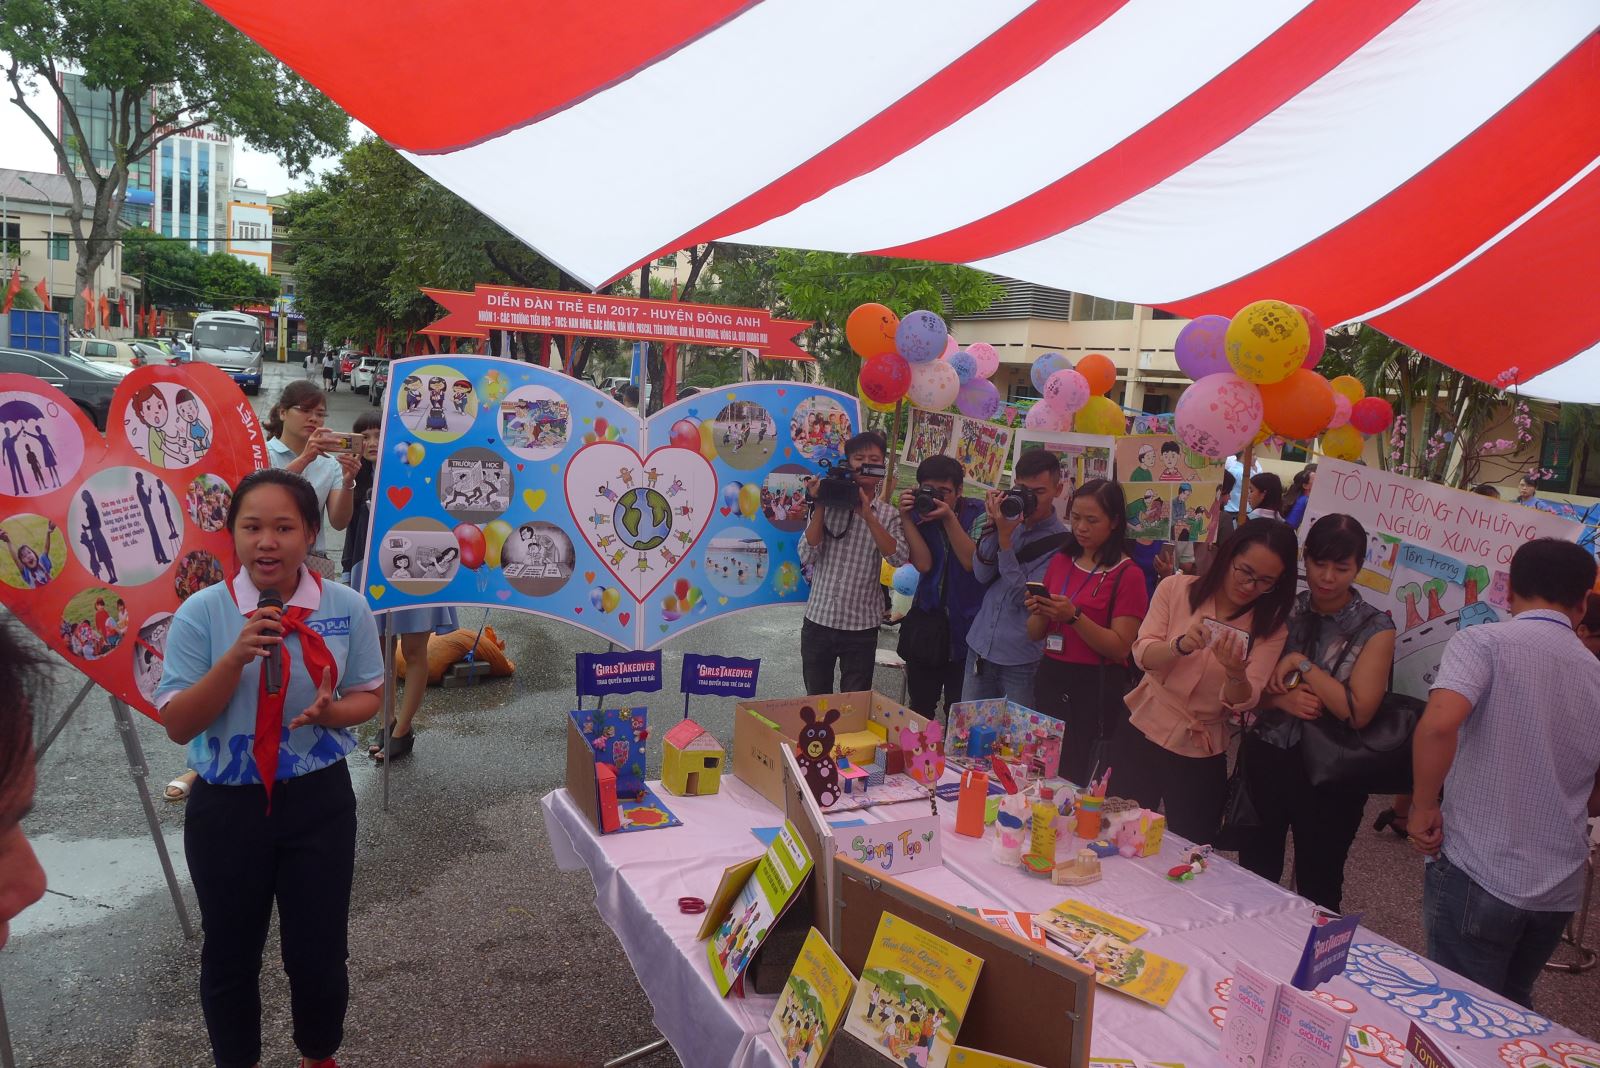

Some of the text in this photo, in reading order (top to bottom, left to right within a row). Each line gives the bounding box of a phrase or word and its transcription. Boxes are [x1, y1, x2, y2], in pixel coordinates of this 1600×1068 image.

[487, 292, 520, 308] DIỄN
[524, 297, 553, 310] ĐÀN
[557, 298, 584, 312] TRẺ
[588, 303, 607, 315] EM
[610, 305, 639, 317] 2017
[650, 309, 693, 323] HUYỆN
[697, 312, 732, 325] ĐÔNG
[736, 316, 760, 327] ANH
[1332, 469, 1382, 502] TÔN
[1403, 546, 1424, 564] Tôn
[1441, 529, 1491, 557] XUNG
